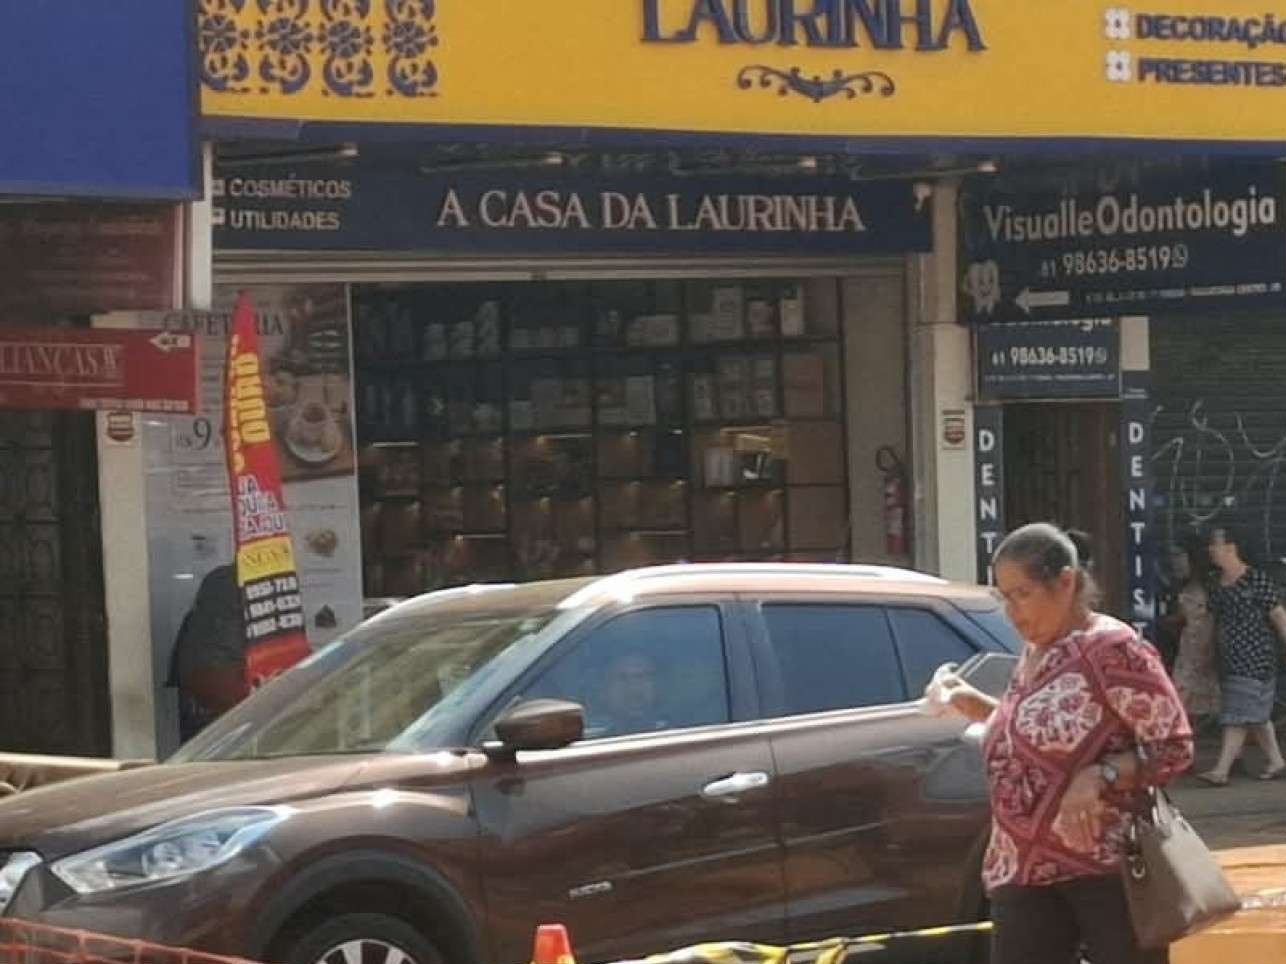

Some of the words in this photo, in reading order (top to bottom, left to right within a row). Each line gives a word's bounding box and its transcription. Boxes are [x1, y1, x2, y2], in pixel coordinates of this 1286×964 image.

[641, 0, 988, 51] LAURINHA
[230, 173, 352, 198] COSMÉTICOS
[230, 211, 340, 230] UTILIDADES
[437, 187, 469, 227] A
[480, 190, 589, 229] CASA
[601, 192, 656, 230] DA
[668, 194, 867, 232] LAURINHA
